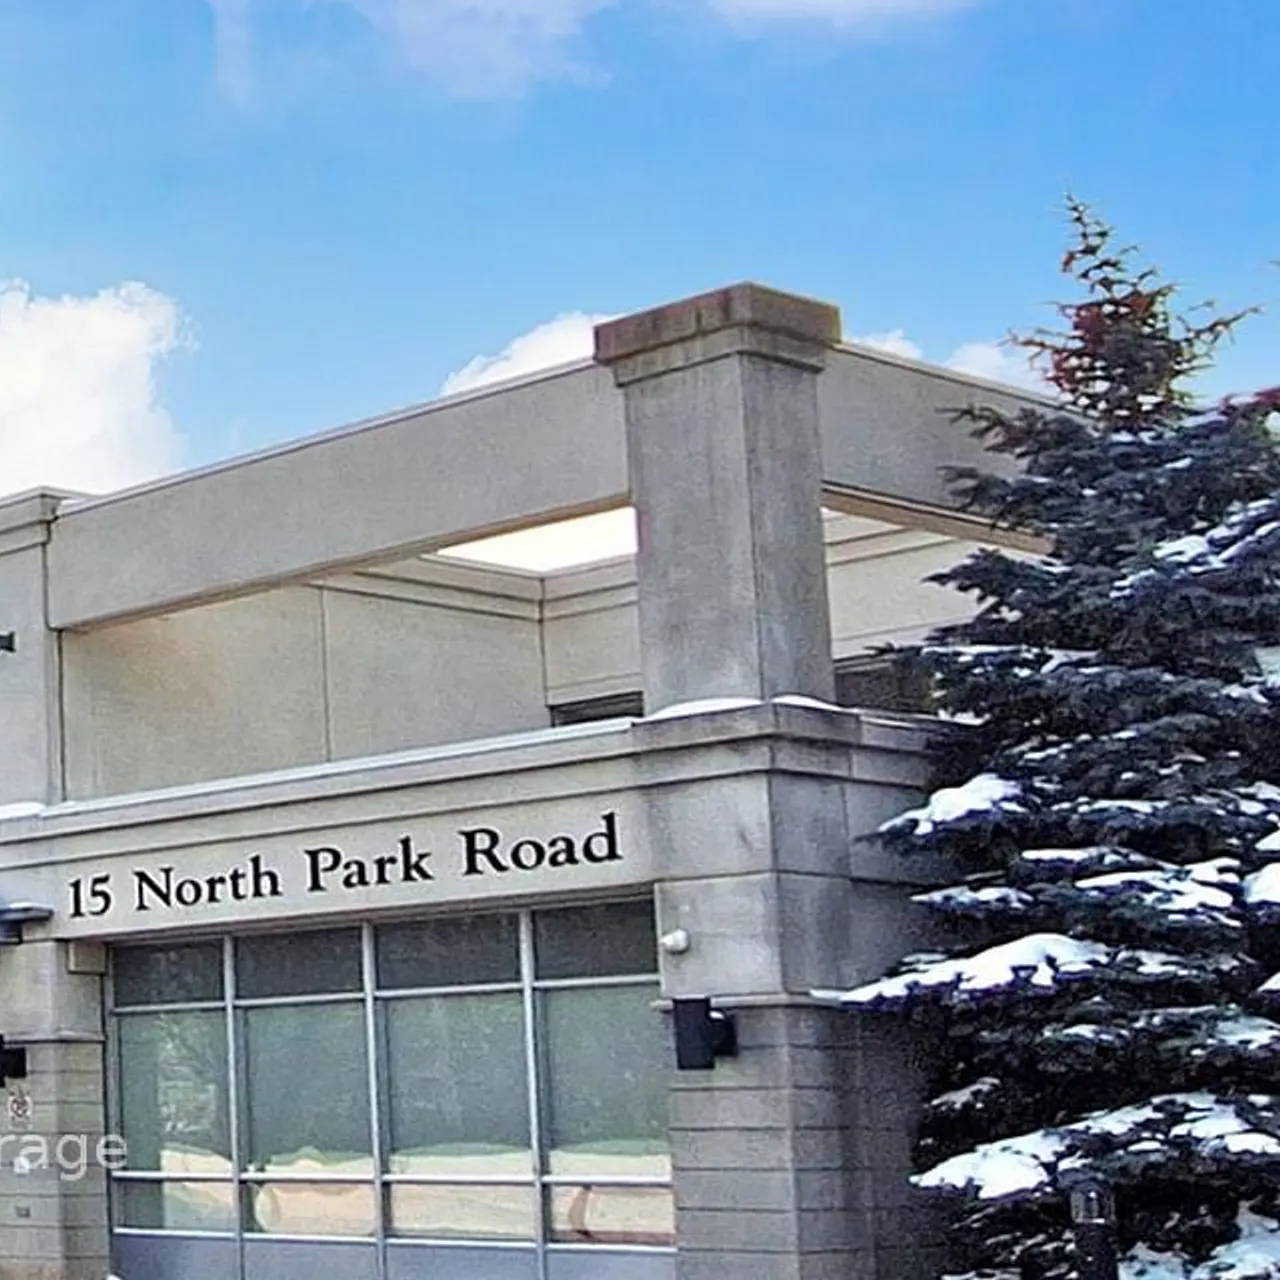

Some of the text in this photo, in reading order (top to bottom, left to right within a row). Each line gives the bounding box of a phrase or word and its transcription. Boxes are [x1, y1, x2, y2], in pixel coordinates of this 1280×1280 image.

[69, 811, 623, 917] 15 North Park Road
